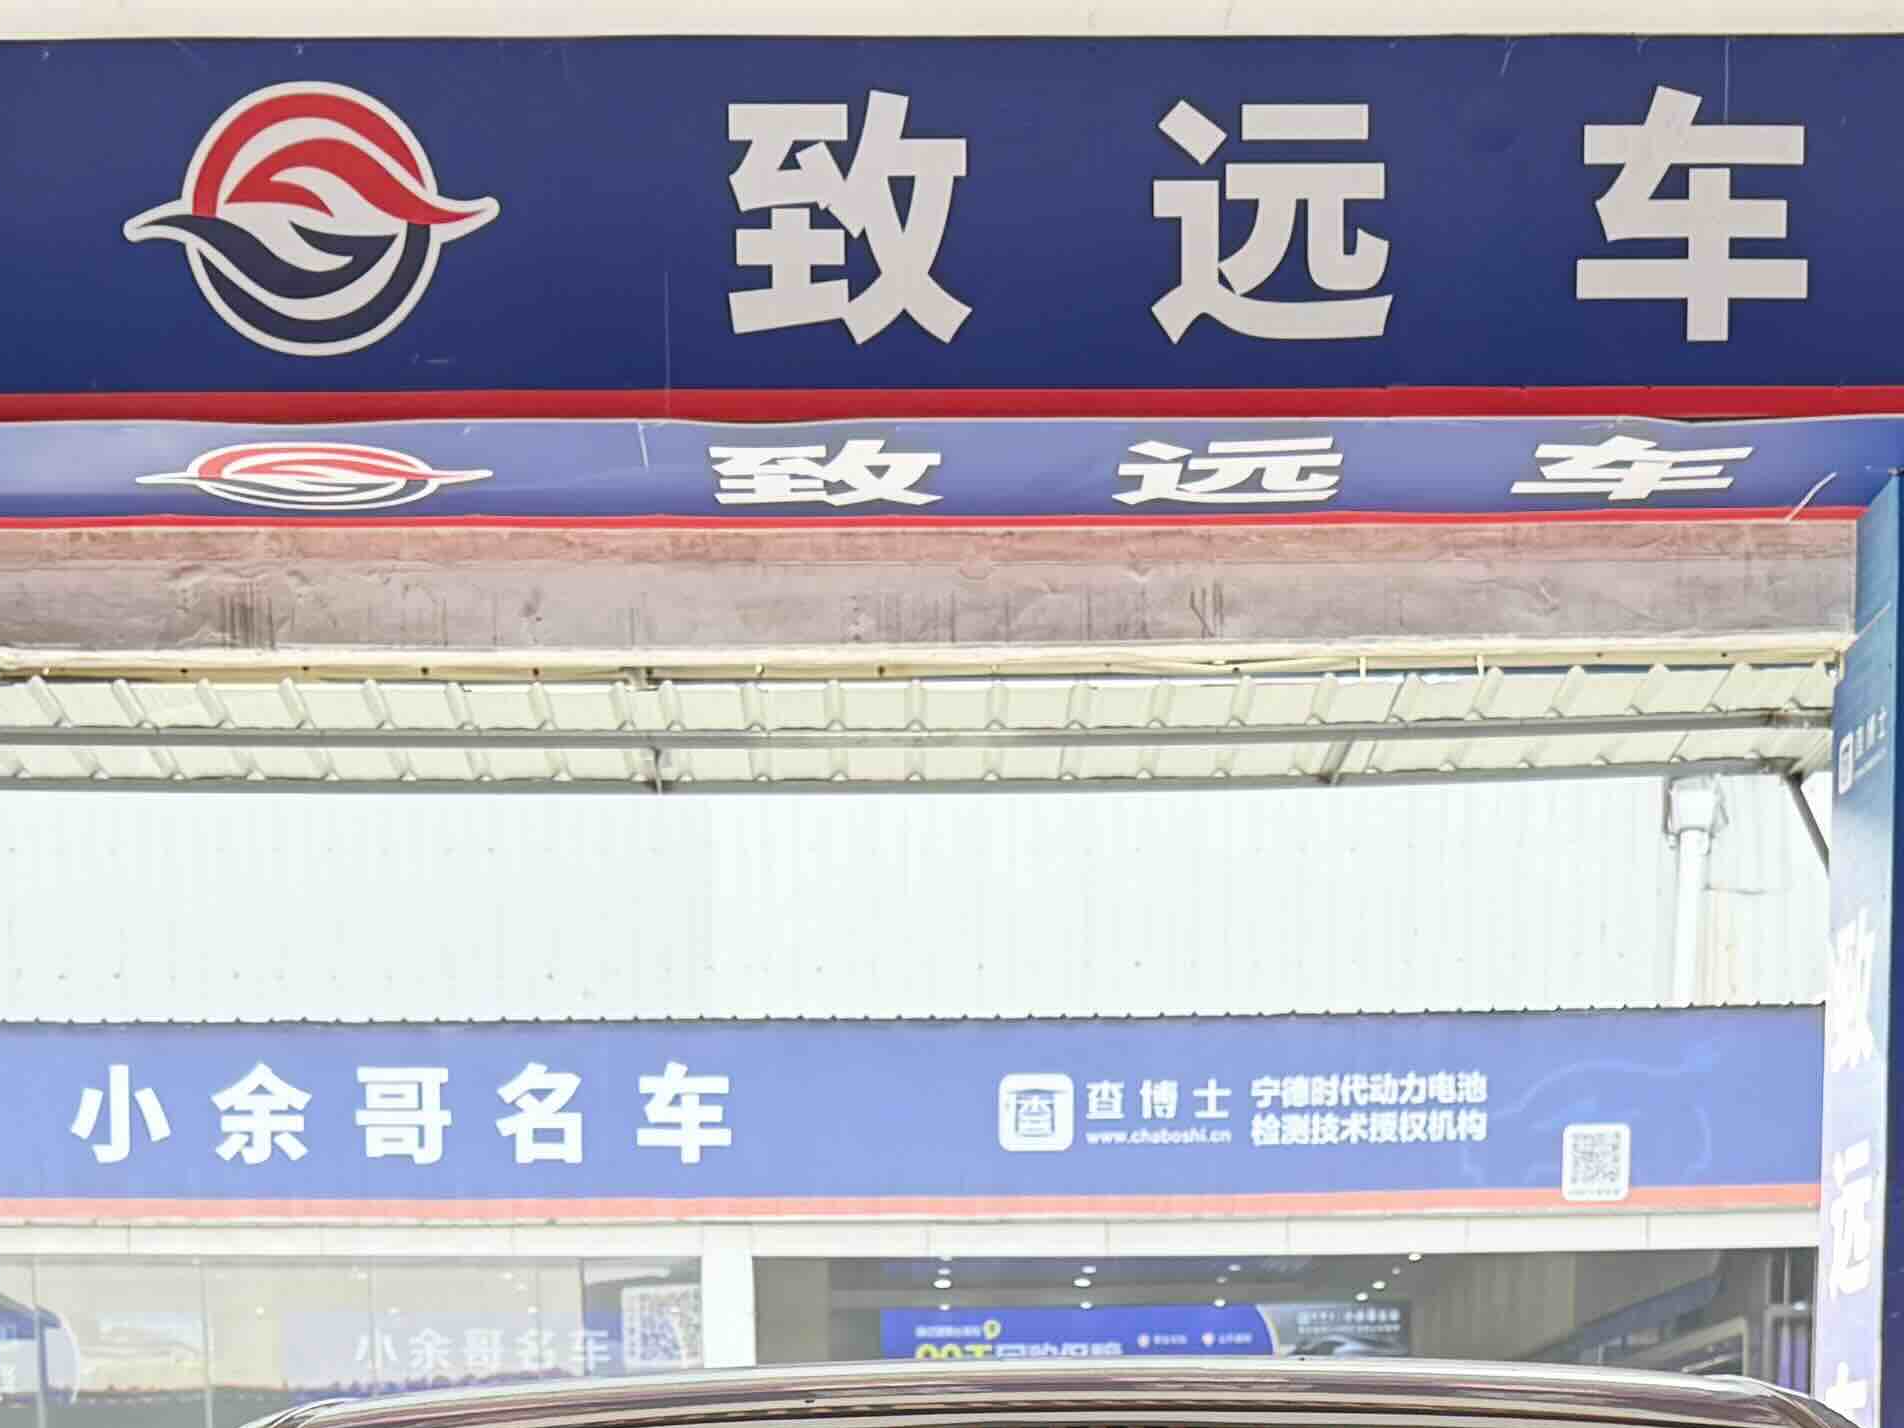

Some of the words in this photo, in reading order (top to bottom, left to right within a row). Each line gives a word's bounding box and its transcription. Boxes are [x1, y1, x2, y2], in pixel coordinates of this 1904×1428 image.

[1085, 1079, 1233, 1120] 查博士
[1250, 1071, 1488, 1110] 宁德时代动力电池
[70, 1061, 733, 1166] 小余哥名车
[1250, 1110, 1488, 1146] 检测技术授权机构
